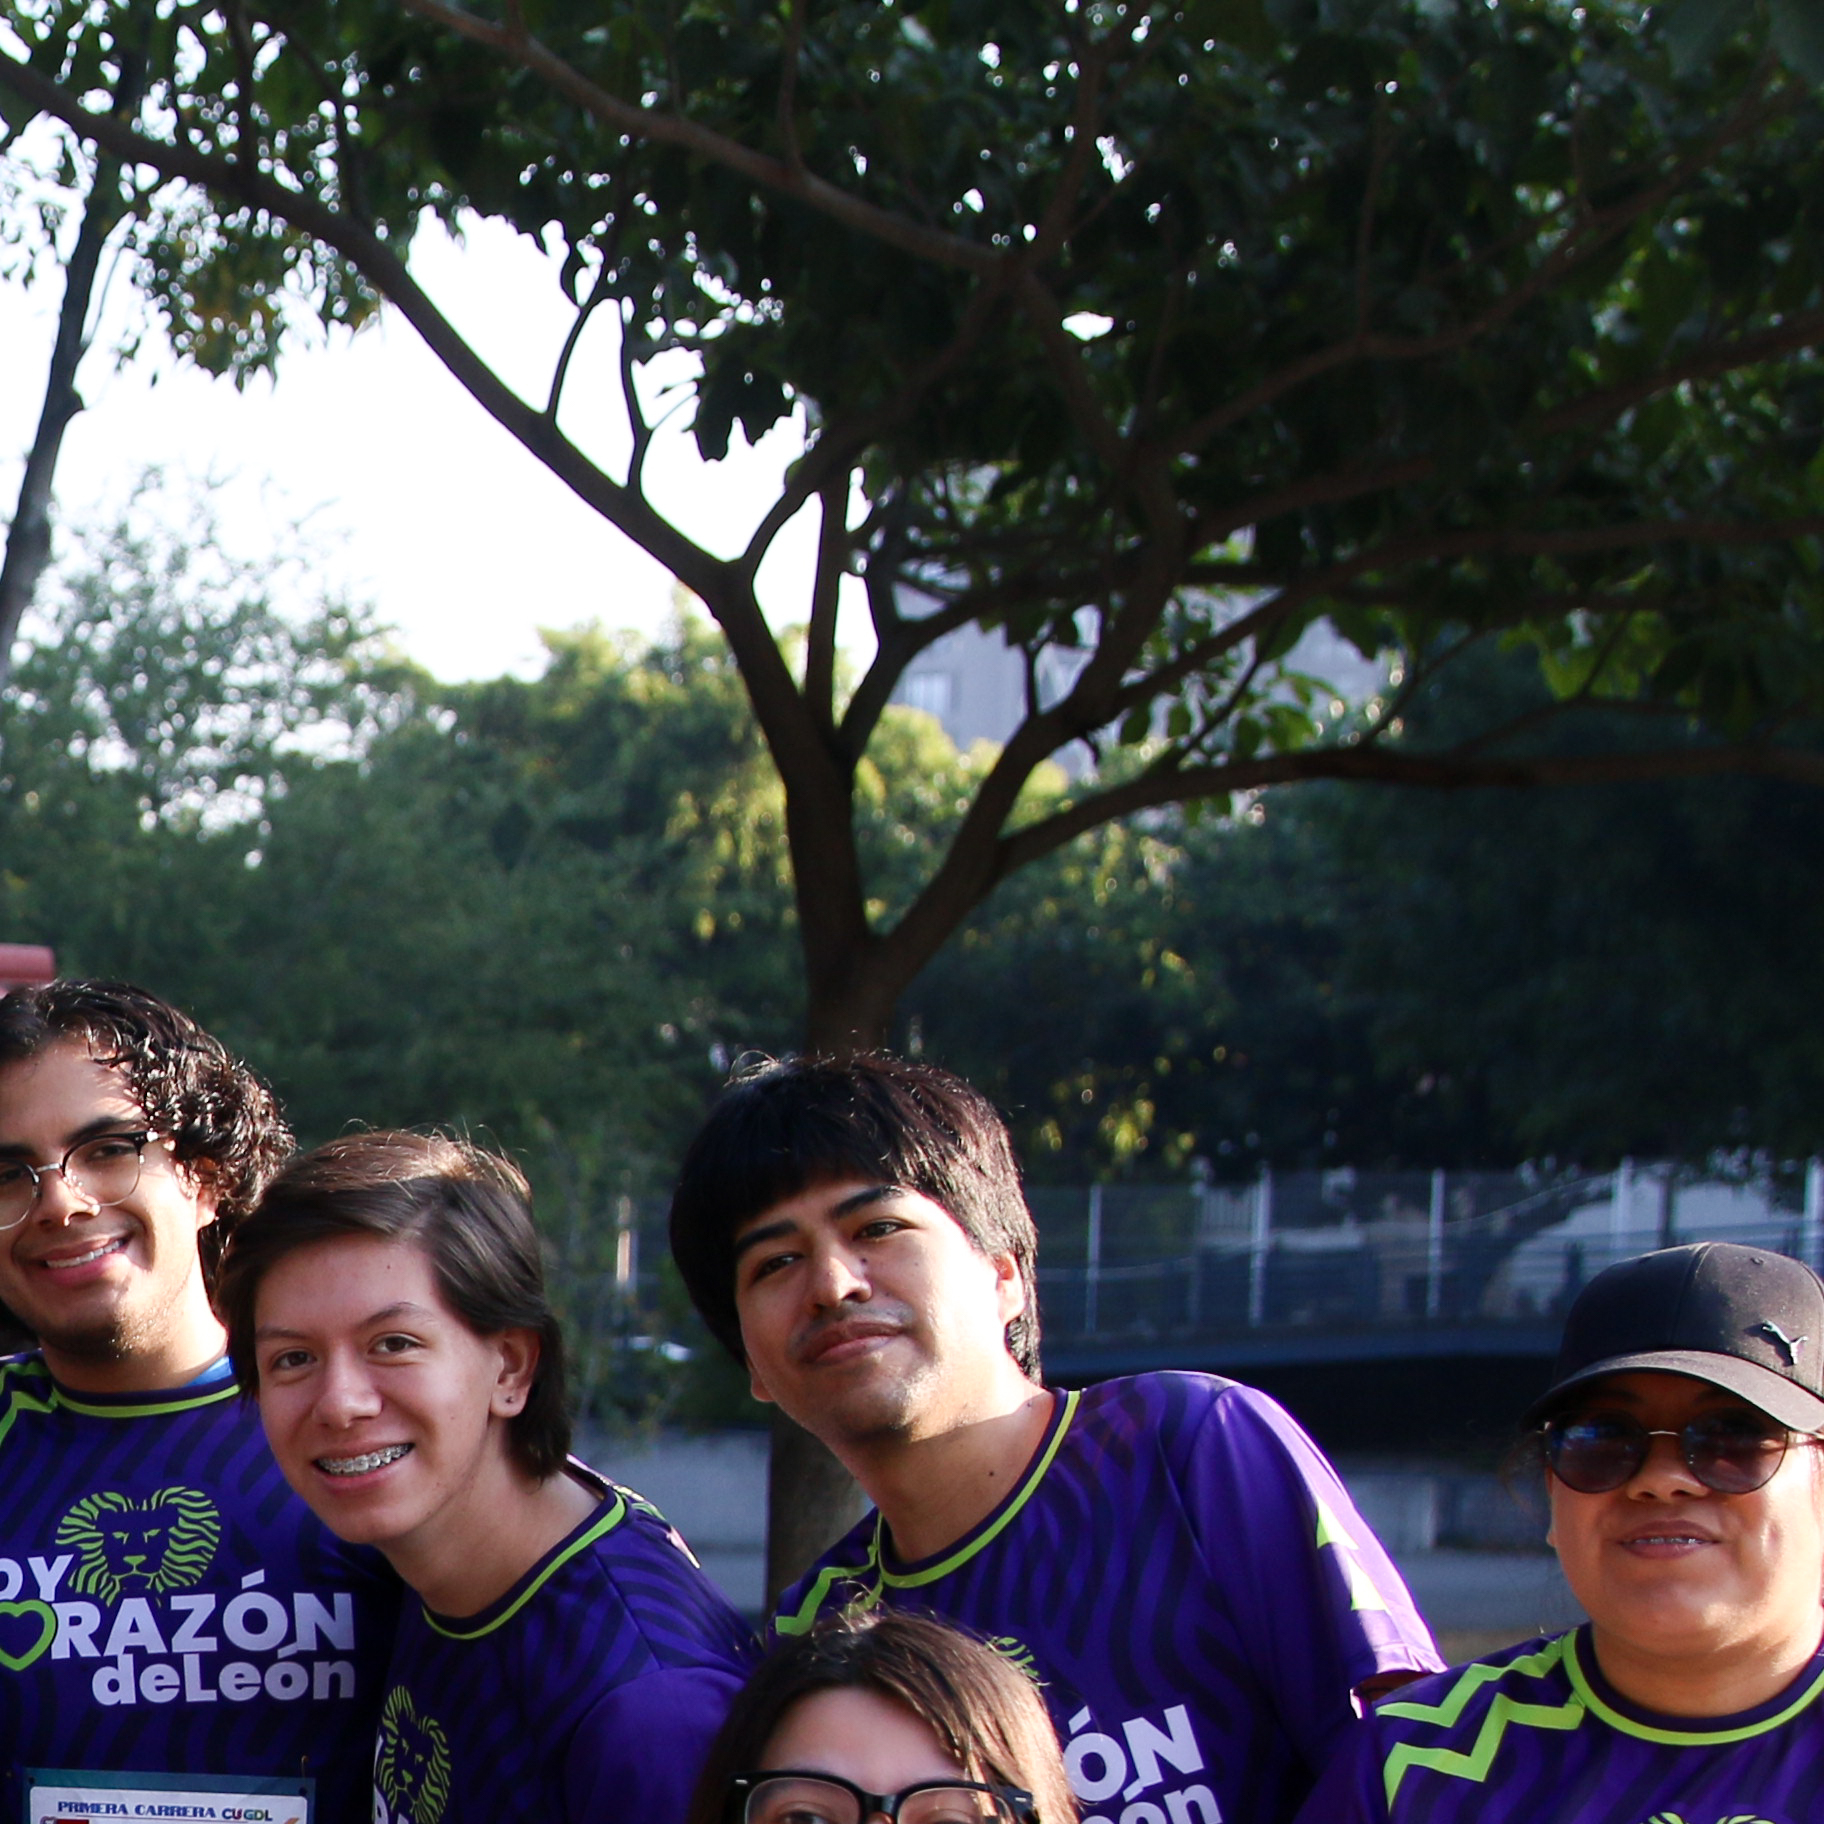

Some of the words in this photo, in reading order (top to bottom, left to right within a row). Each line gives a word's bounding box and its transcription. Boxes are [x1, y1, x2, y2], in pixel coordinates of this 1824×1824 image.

[92, 1642, 355, 1706] deLeón
[58, 1801, 128, 1818] PRIMERA
[134, 1803, 217, 1820] CARRERA
[222, 1807, 273, 1823] CUGDL
